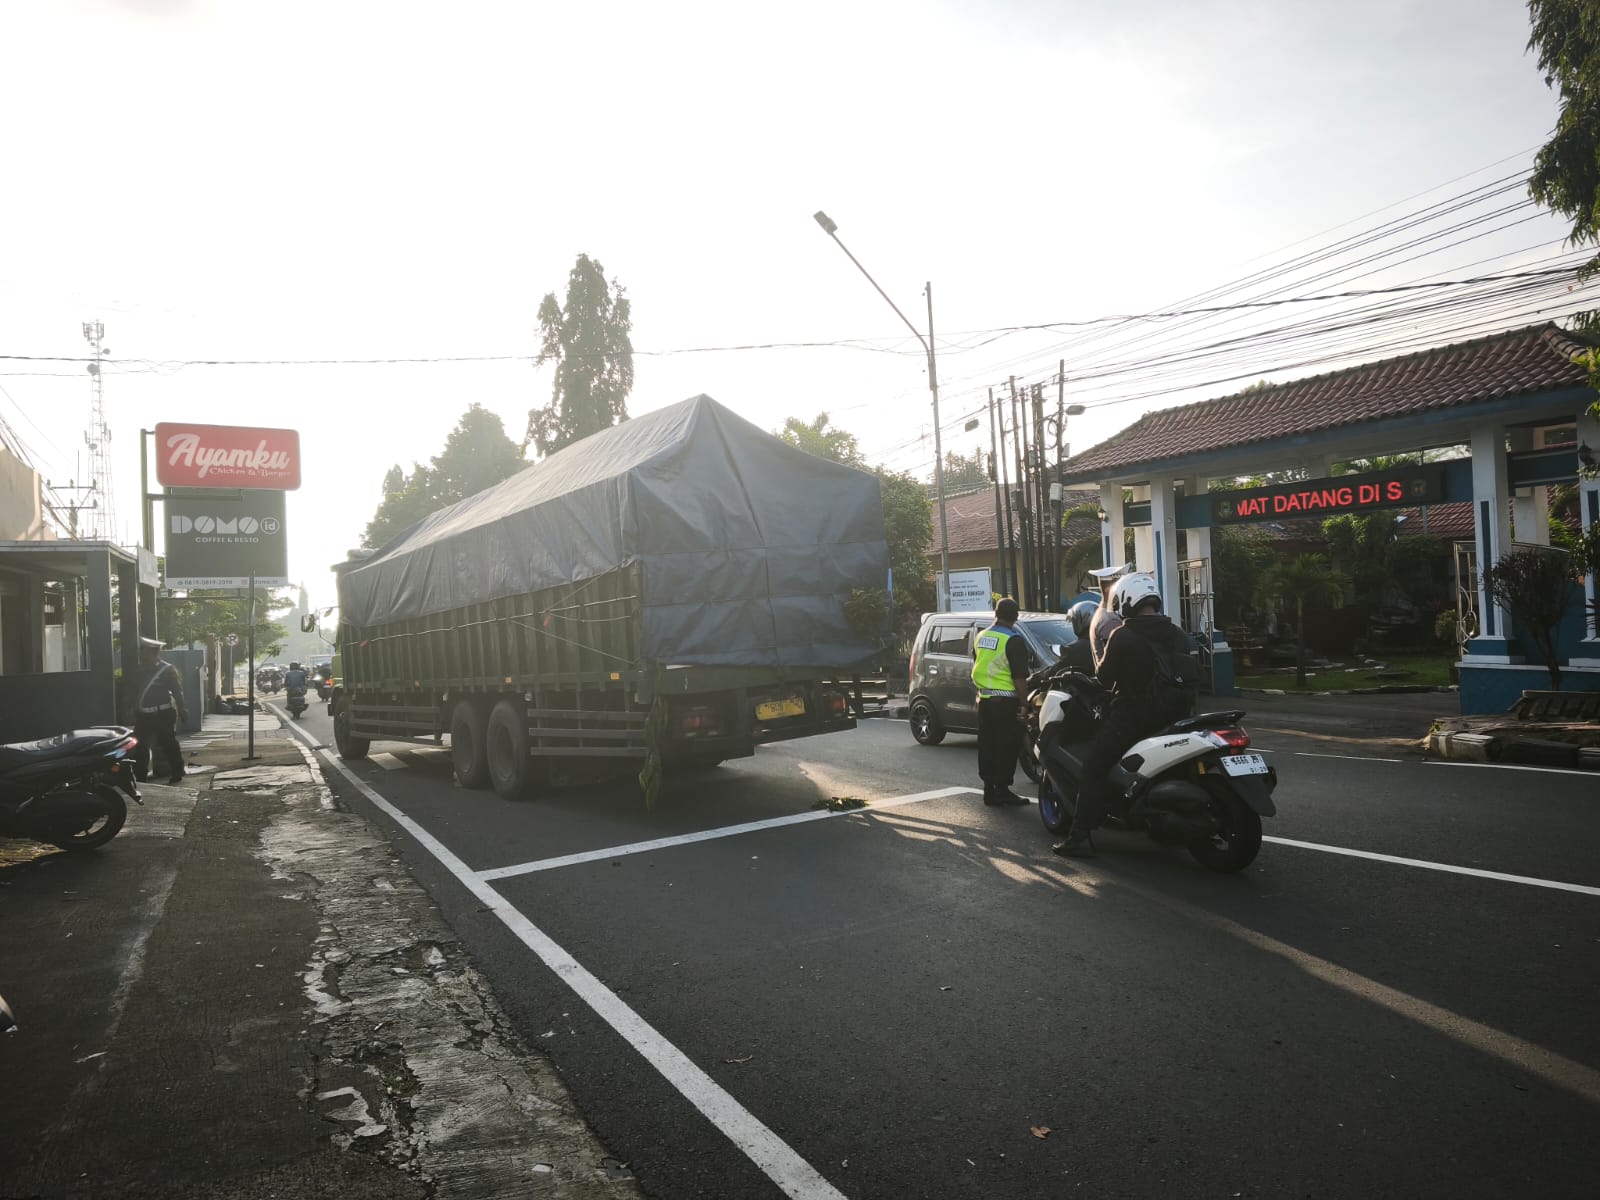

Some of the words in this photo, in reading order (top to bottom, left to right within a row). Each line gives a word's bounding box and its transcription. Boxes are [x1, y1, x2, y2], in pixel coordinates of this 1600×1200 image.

[166, 433, 290, 478] Ayamku
[1274, 487, 1352, 512] DATANG
[1359, 484, 1380, 503] DI
[1387, 481, 1402, 500] S
[171, 515, 259, 534] DOMO
